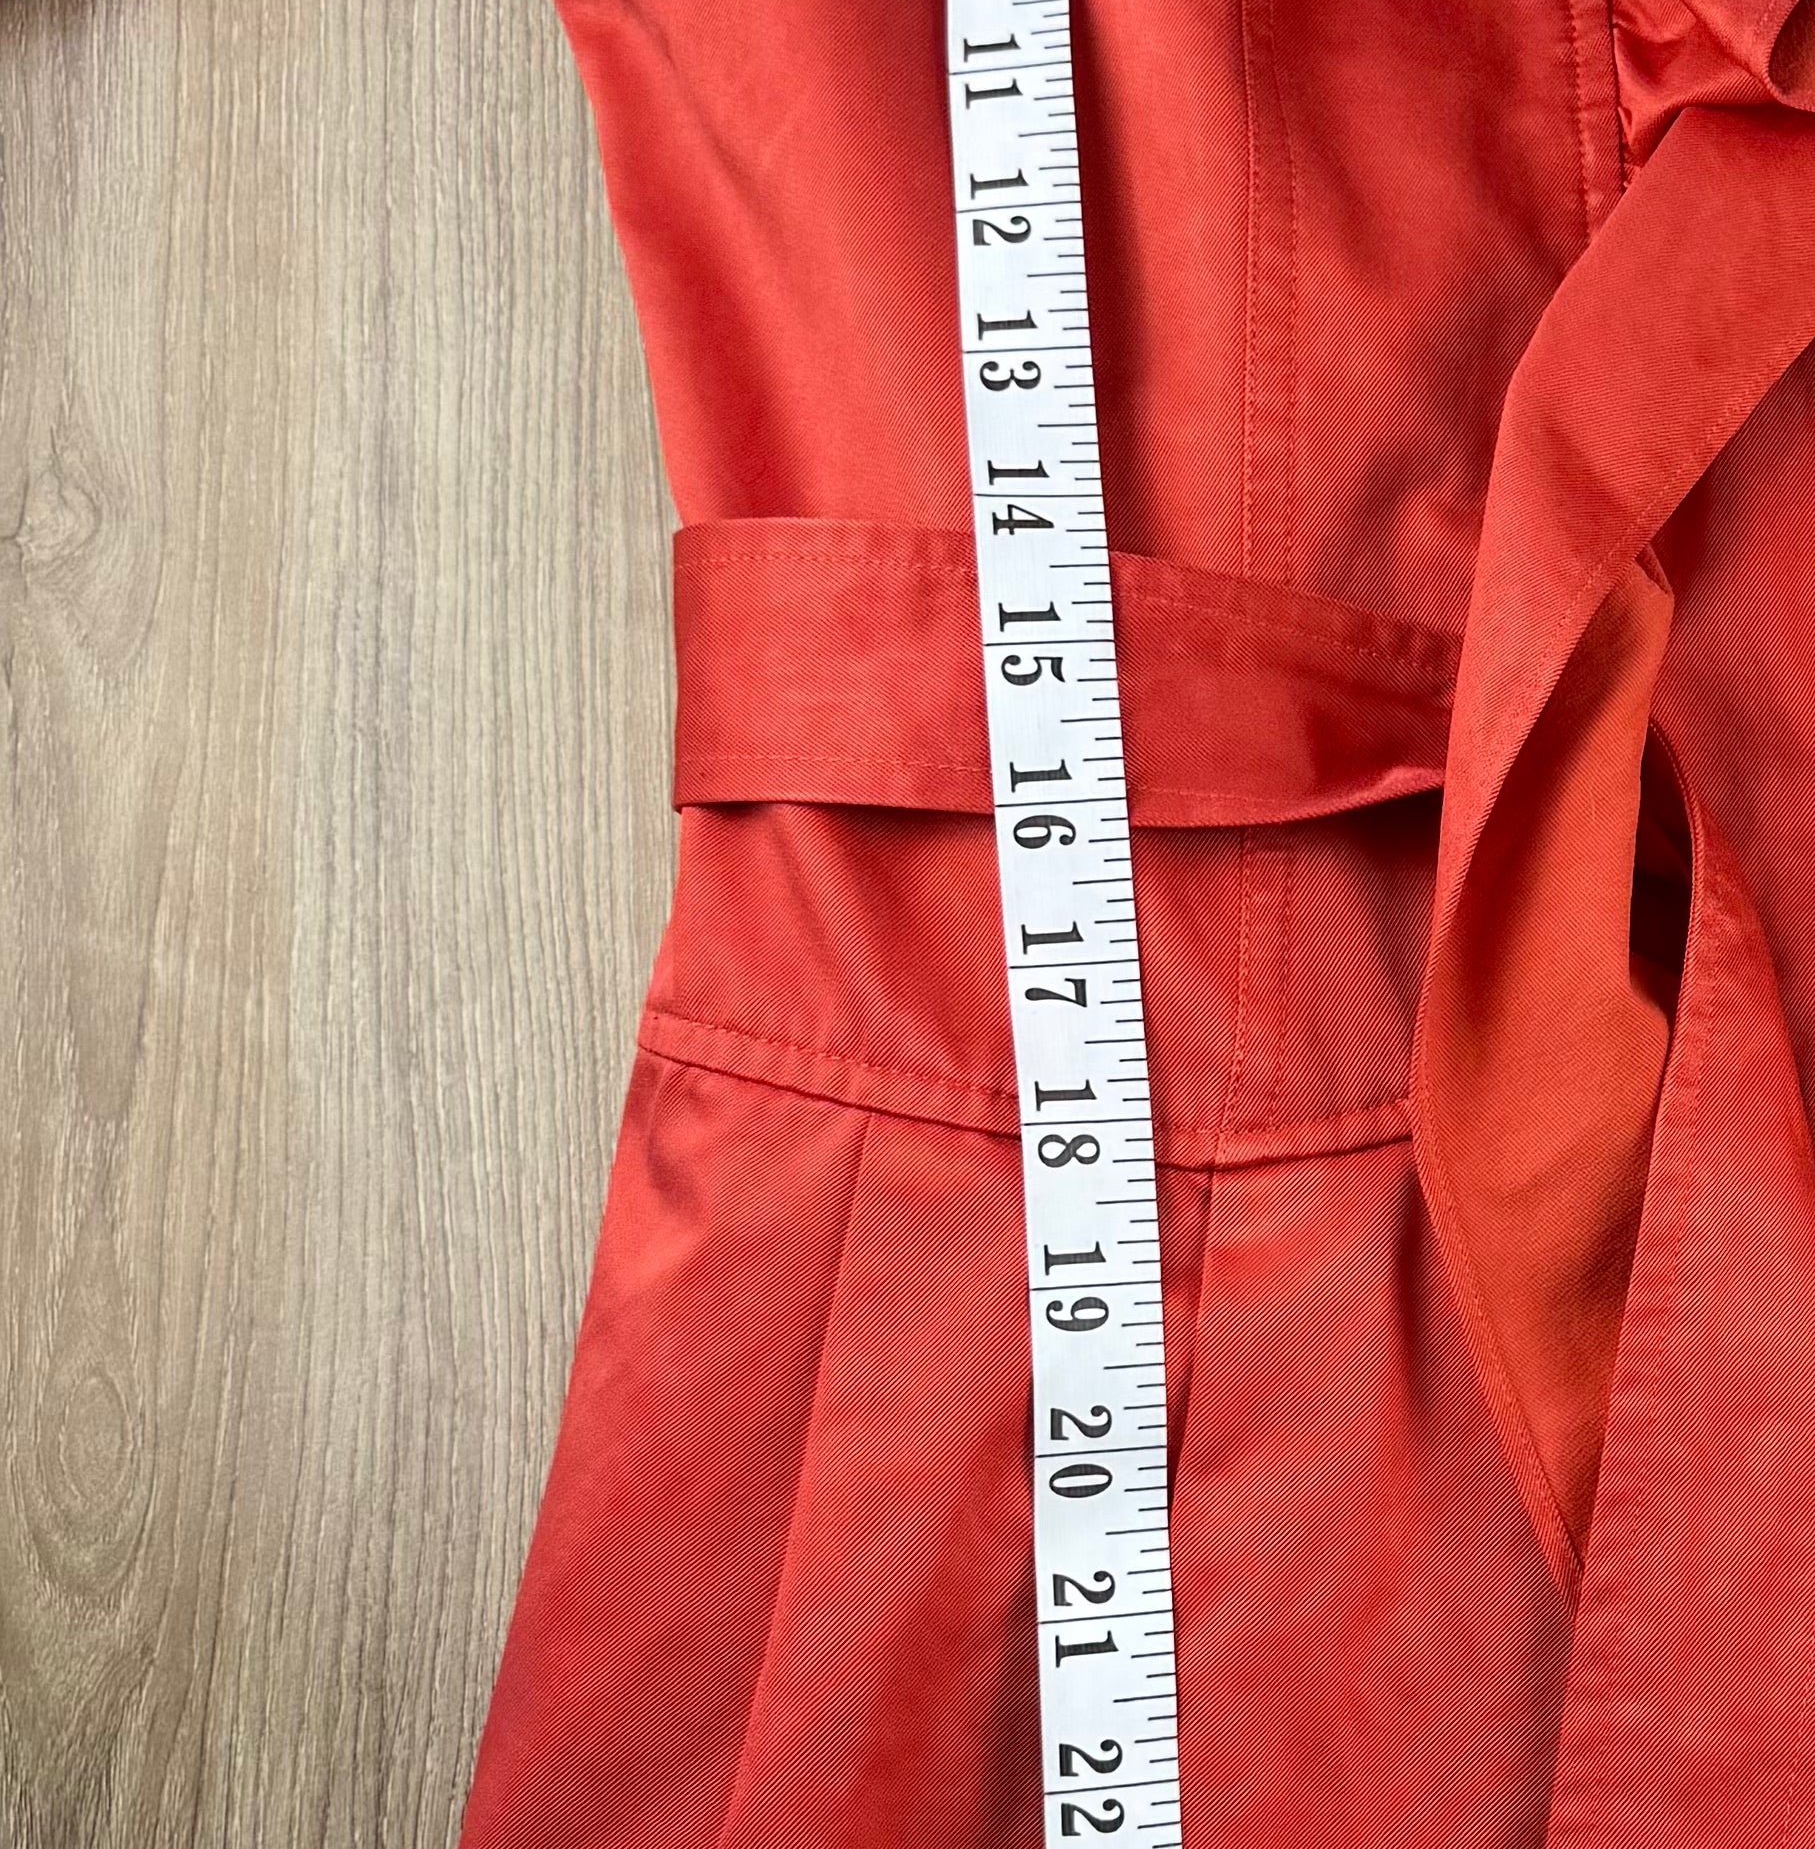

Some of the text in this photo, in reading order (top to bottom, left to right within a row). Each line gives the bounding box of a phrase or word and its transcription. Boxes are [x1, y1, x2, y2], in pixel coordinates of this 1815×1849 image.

[963, 33, 1023, 110] 11
[969, 168, 1032, 246] 12
[976, 309, 1042, 392] 13
[987, 459, 1055, 536] 14
[997, 601, 1066, 687] 15
[1009, 758, 1077, 850] 16
[1020, 920, 1088, 1008] 17
[1034, 1079, 1101, 1169] 18
[1043, 1240, 1110, 1332] 19
[1048, 1405, 1113, 1499] 20
[1052, 1570, 1119, 1669] 21
[1058, 1739, 1125, 1837] 22
